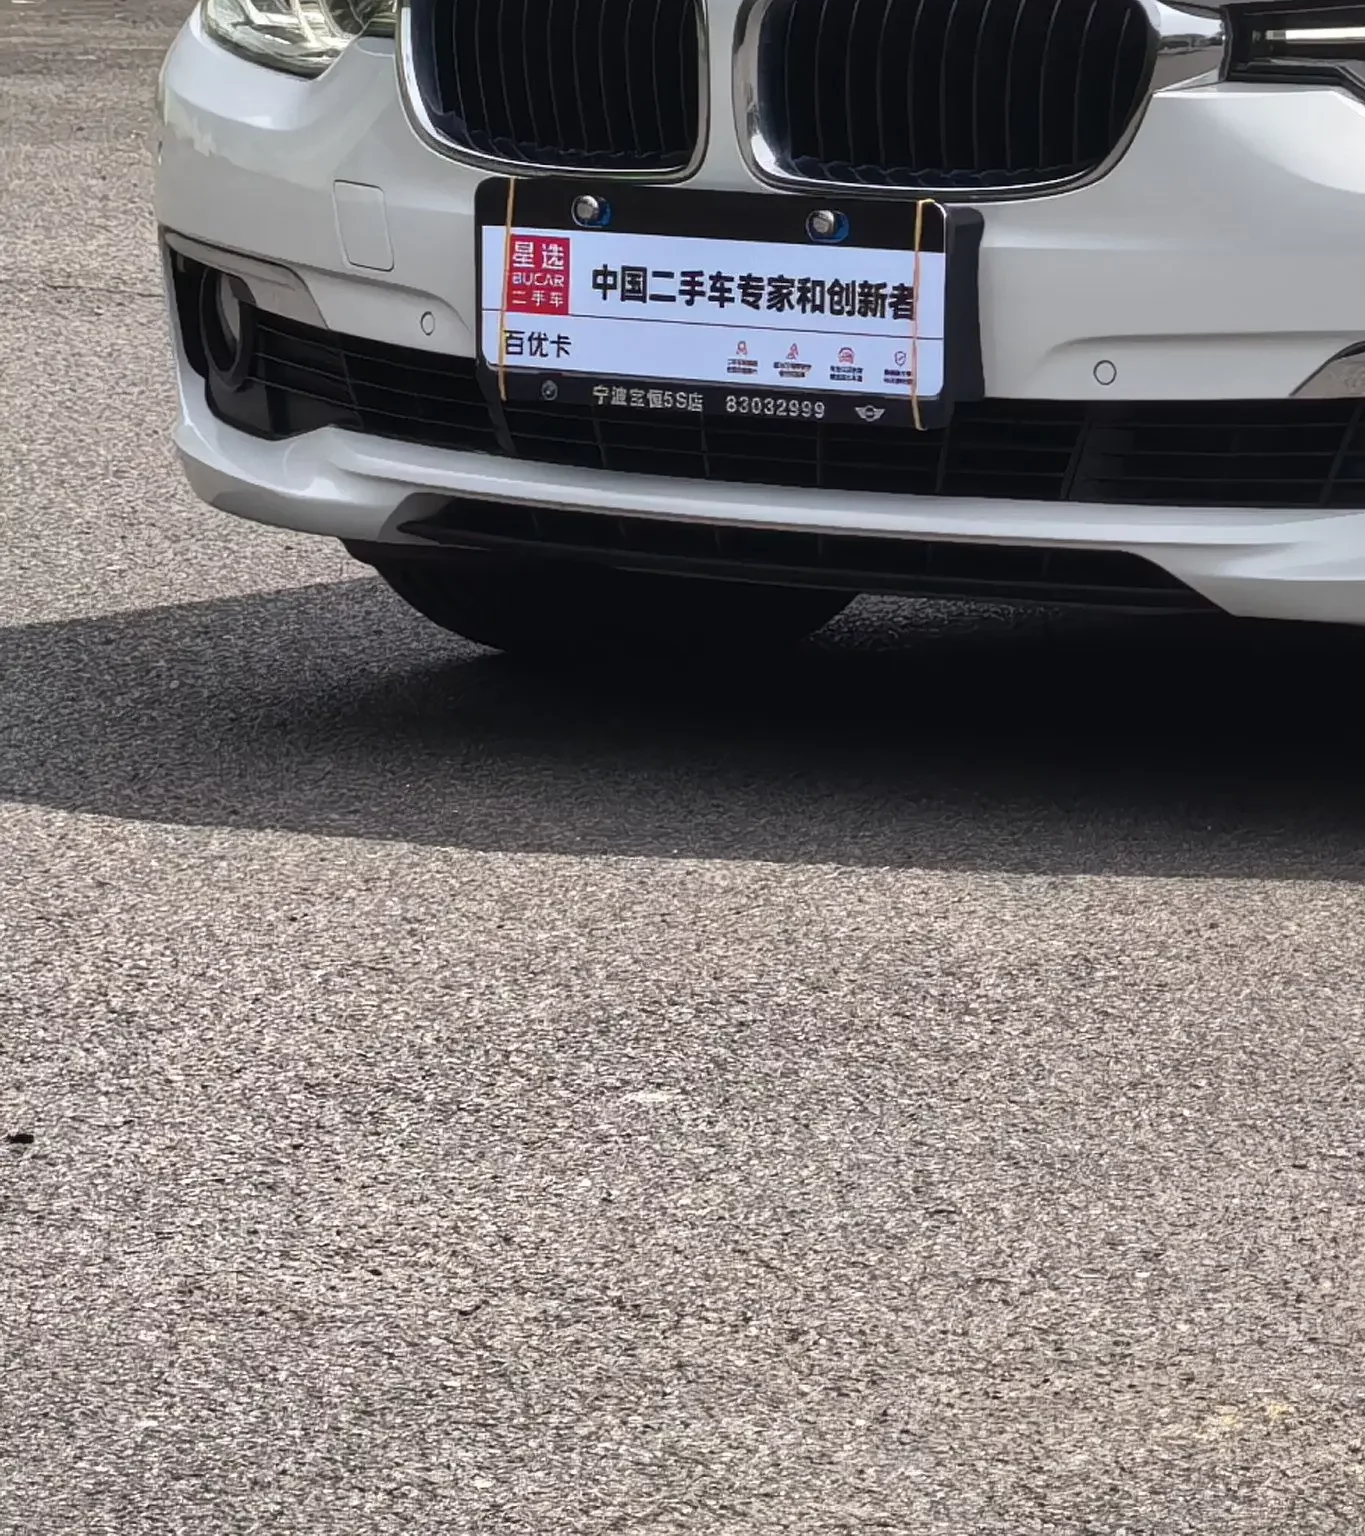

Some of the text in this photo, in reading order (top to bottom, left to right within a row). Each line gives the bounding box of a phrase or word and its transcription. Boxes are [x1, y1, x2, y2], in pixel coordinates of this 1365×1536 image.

[512, 241, 565, 270] 星选
[512, 272, 565, 288] BUCAR
[592, 263, 914, 321] 中国二手车专家和创新者
[512, 290, 564, 308] 二手车
[503, 330, 572, 358] 百优卡
[725, 395, 826, 420] 83032999
